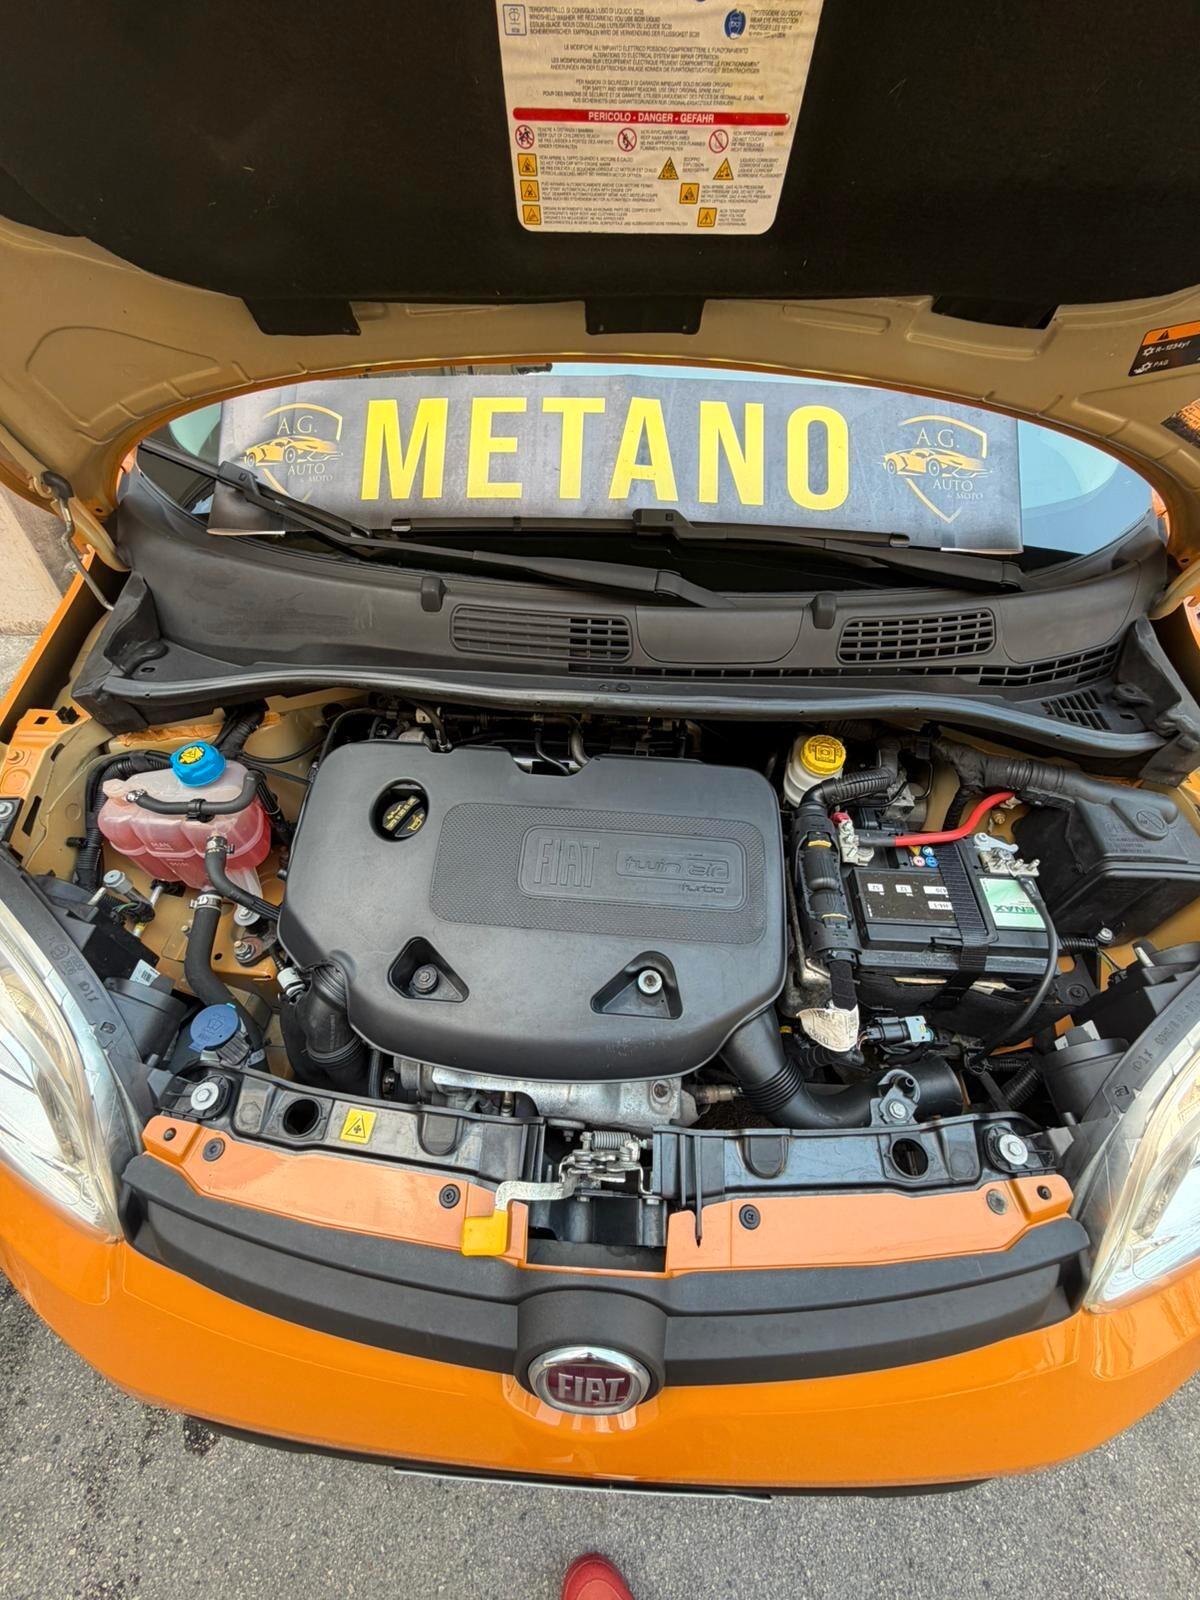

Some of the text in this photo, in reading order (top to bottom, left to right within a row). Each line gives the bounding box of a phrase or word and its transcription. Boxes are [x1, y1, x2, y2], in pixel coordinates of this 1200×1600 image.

[588, 112, 631, 121] PERICOLO
[638, 113, 672, 122] DANGER
[680, 114, 714, 122] GEFAHR
[276, 415, 318, 436] A.G.
[916, 427, 960, 448] A.G.
[361, 397, 849, 511] METANO
[288, 463, 326, 476] AUTO
[933, 480, 974, 492] AUTO
[534, 838, 600, 888] FIAT
[558, 1373, 626, 1402] FIAT
